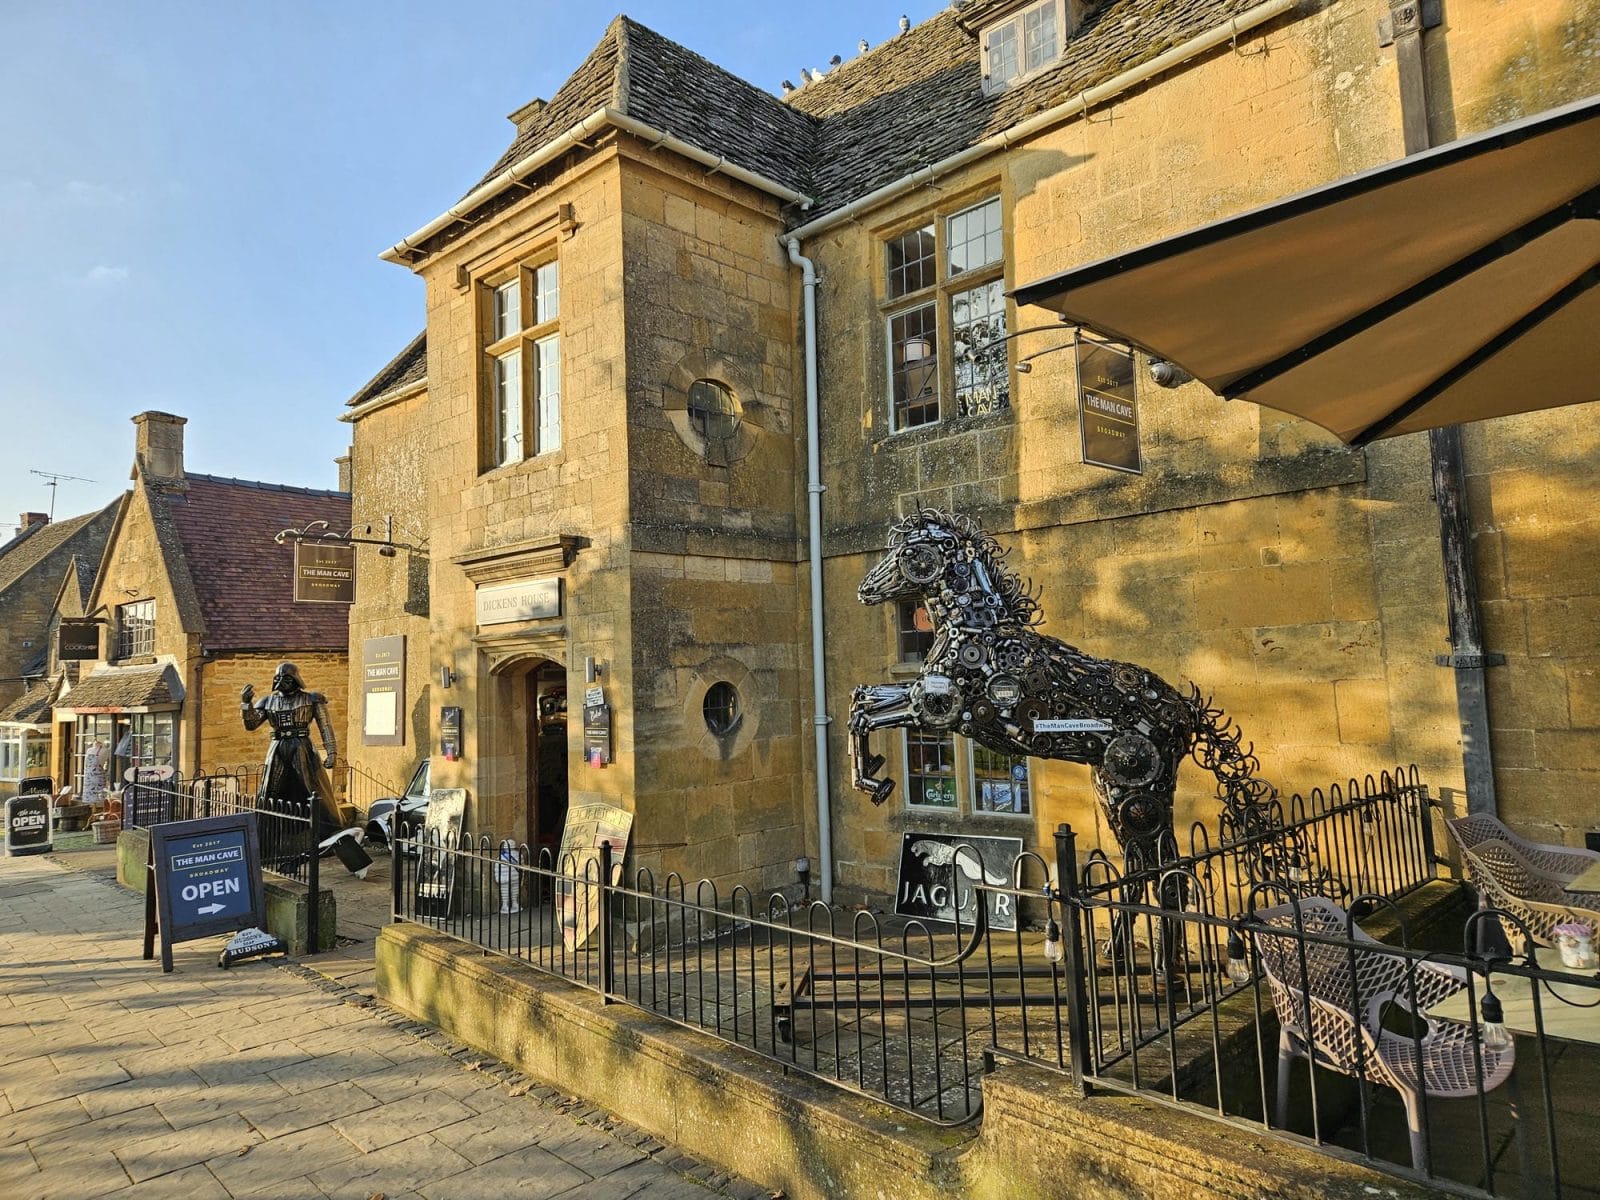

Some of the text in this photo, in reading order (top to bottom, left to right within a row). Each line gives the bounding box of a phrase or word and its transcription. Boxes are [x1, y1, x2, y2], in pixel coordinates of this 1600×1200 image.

[1086, 394, 1133, 418] THE MAN CAVE
[1097, 426, 1126, 438] BROADWAY
[483, 592, 550, 611] DICKENS HOUSE
[367, 666, 398, 677] THE MAN CAVE
[926, 789, 955, 802] Carlserg
[12, 814, 46, 827] OPEN
[176, 850, 239, 866] THE MAN CAVE
[189, 868, 229, 878] BROADWAY
[181, 877, 240, 901] OPEN
[901, 881, 1010, 917] JAGUR
[230, 940, 278, 956] HUDSON'S
